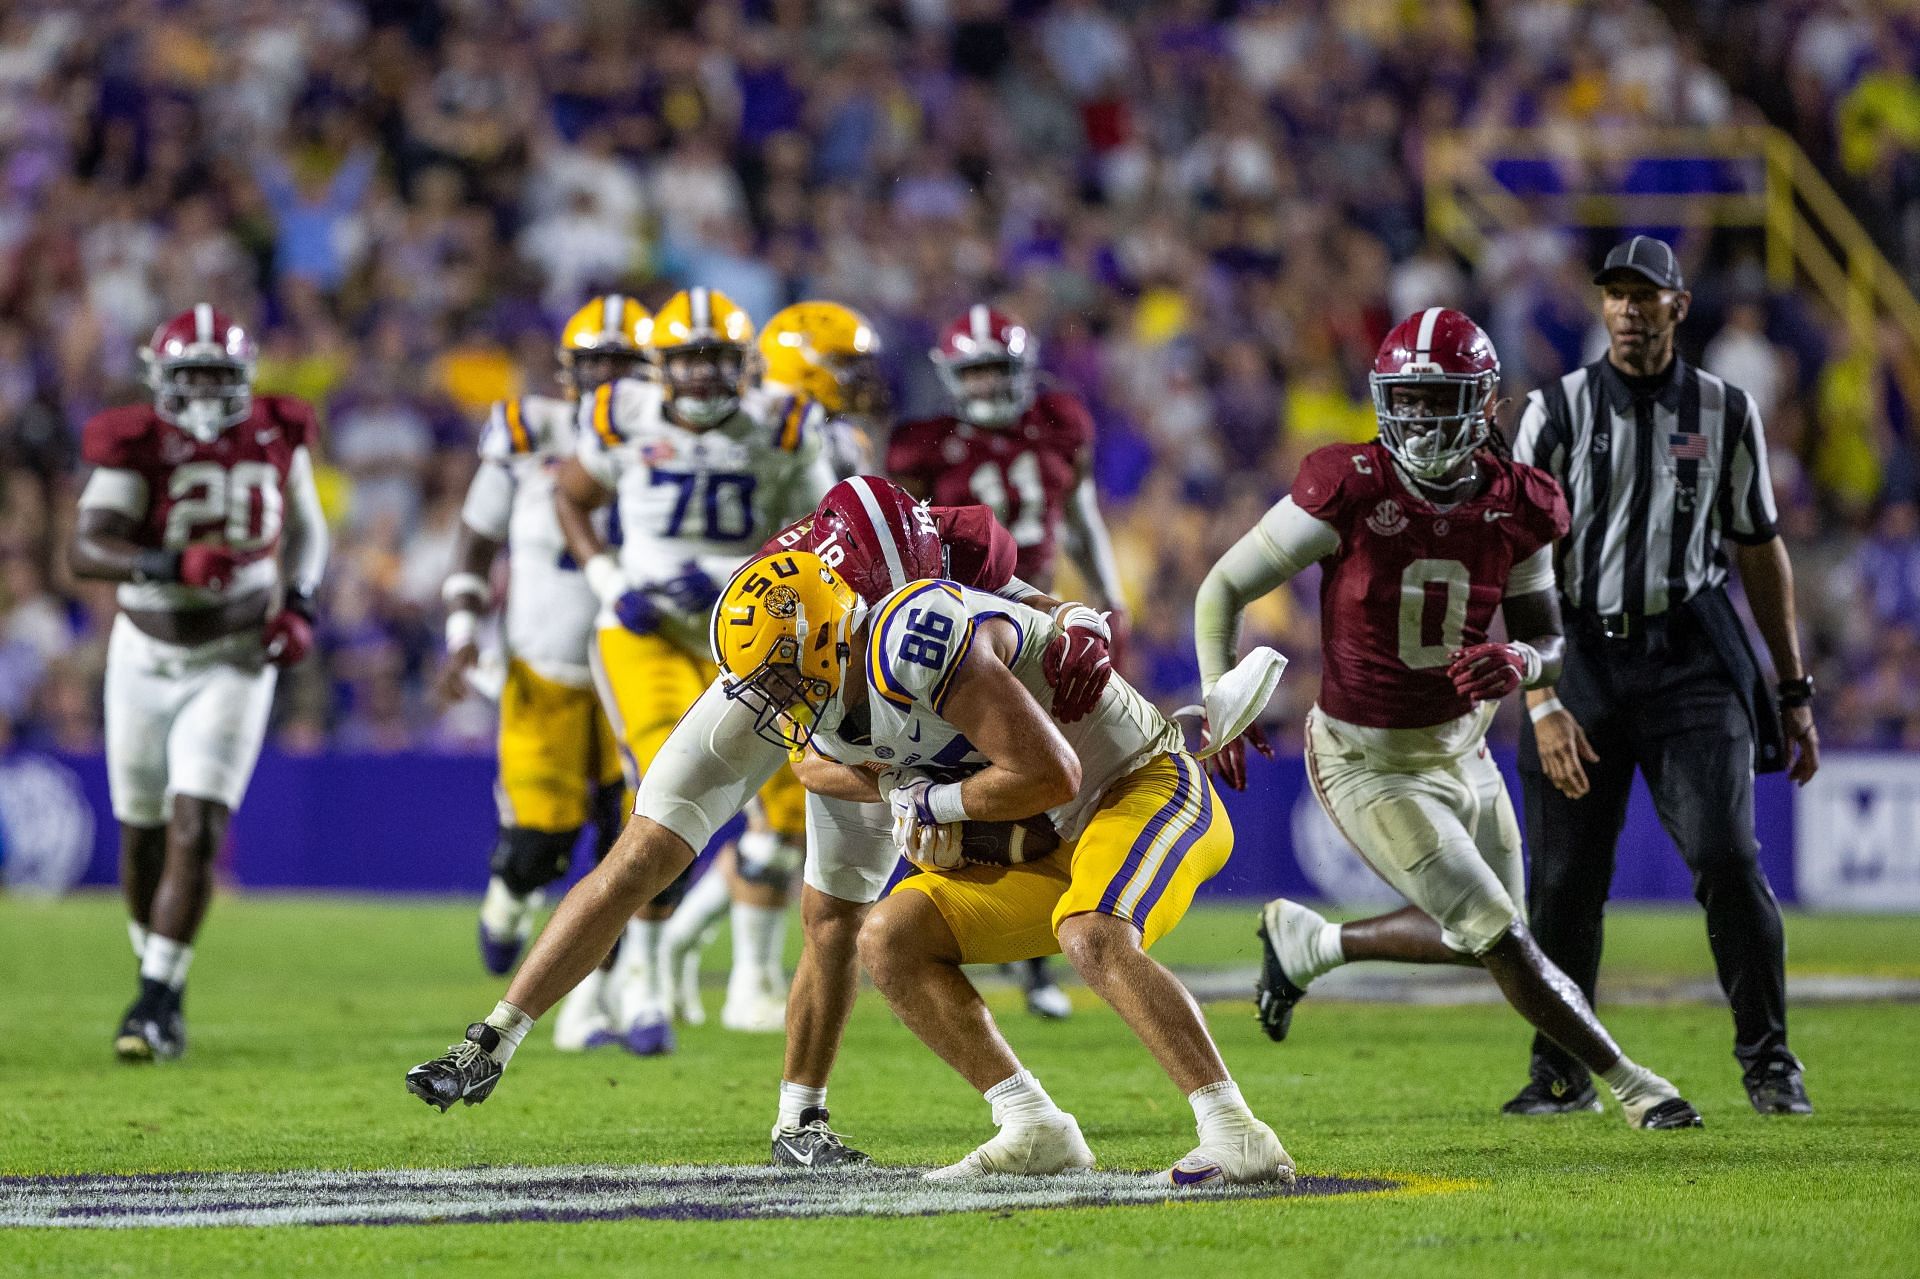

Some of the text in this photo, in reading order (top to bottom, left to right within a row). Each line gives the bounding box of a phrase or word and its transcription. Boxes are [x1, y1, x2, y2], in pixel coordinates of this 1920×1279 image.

[165, 461, 284, 550] 20
[649, 467, 757, 542] 70
[814, 531, 846, 569] 18
[729, 556, 800, 627] LSU
[1397, 558, 1471, 670] 0
[898, 607, 954, 671] 86
